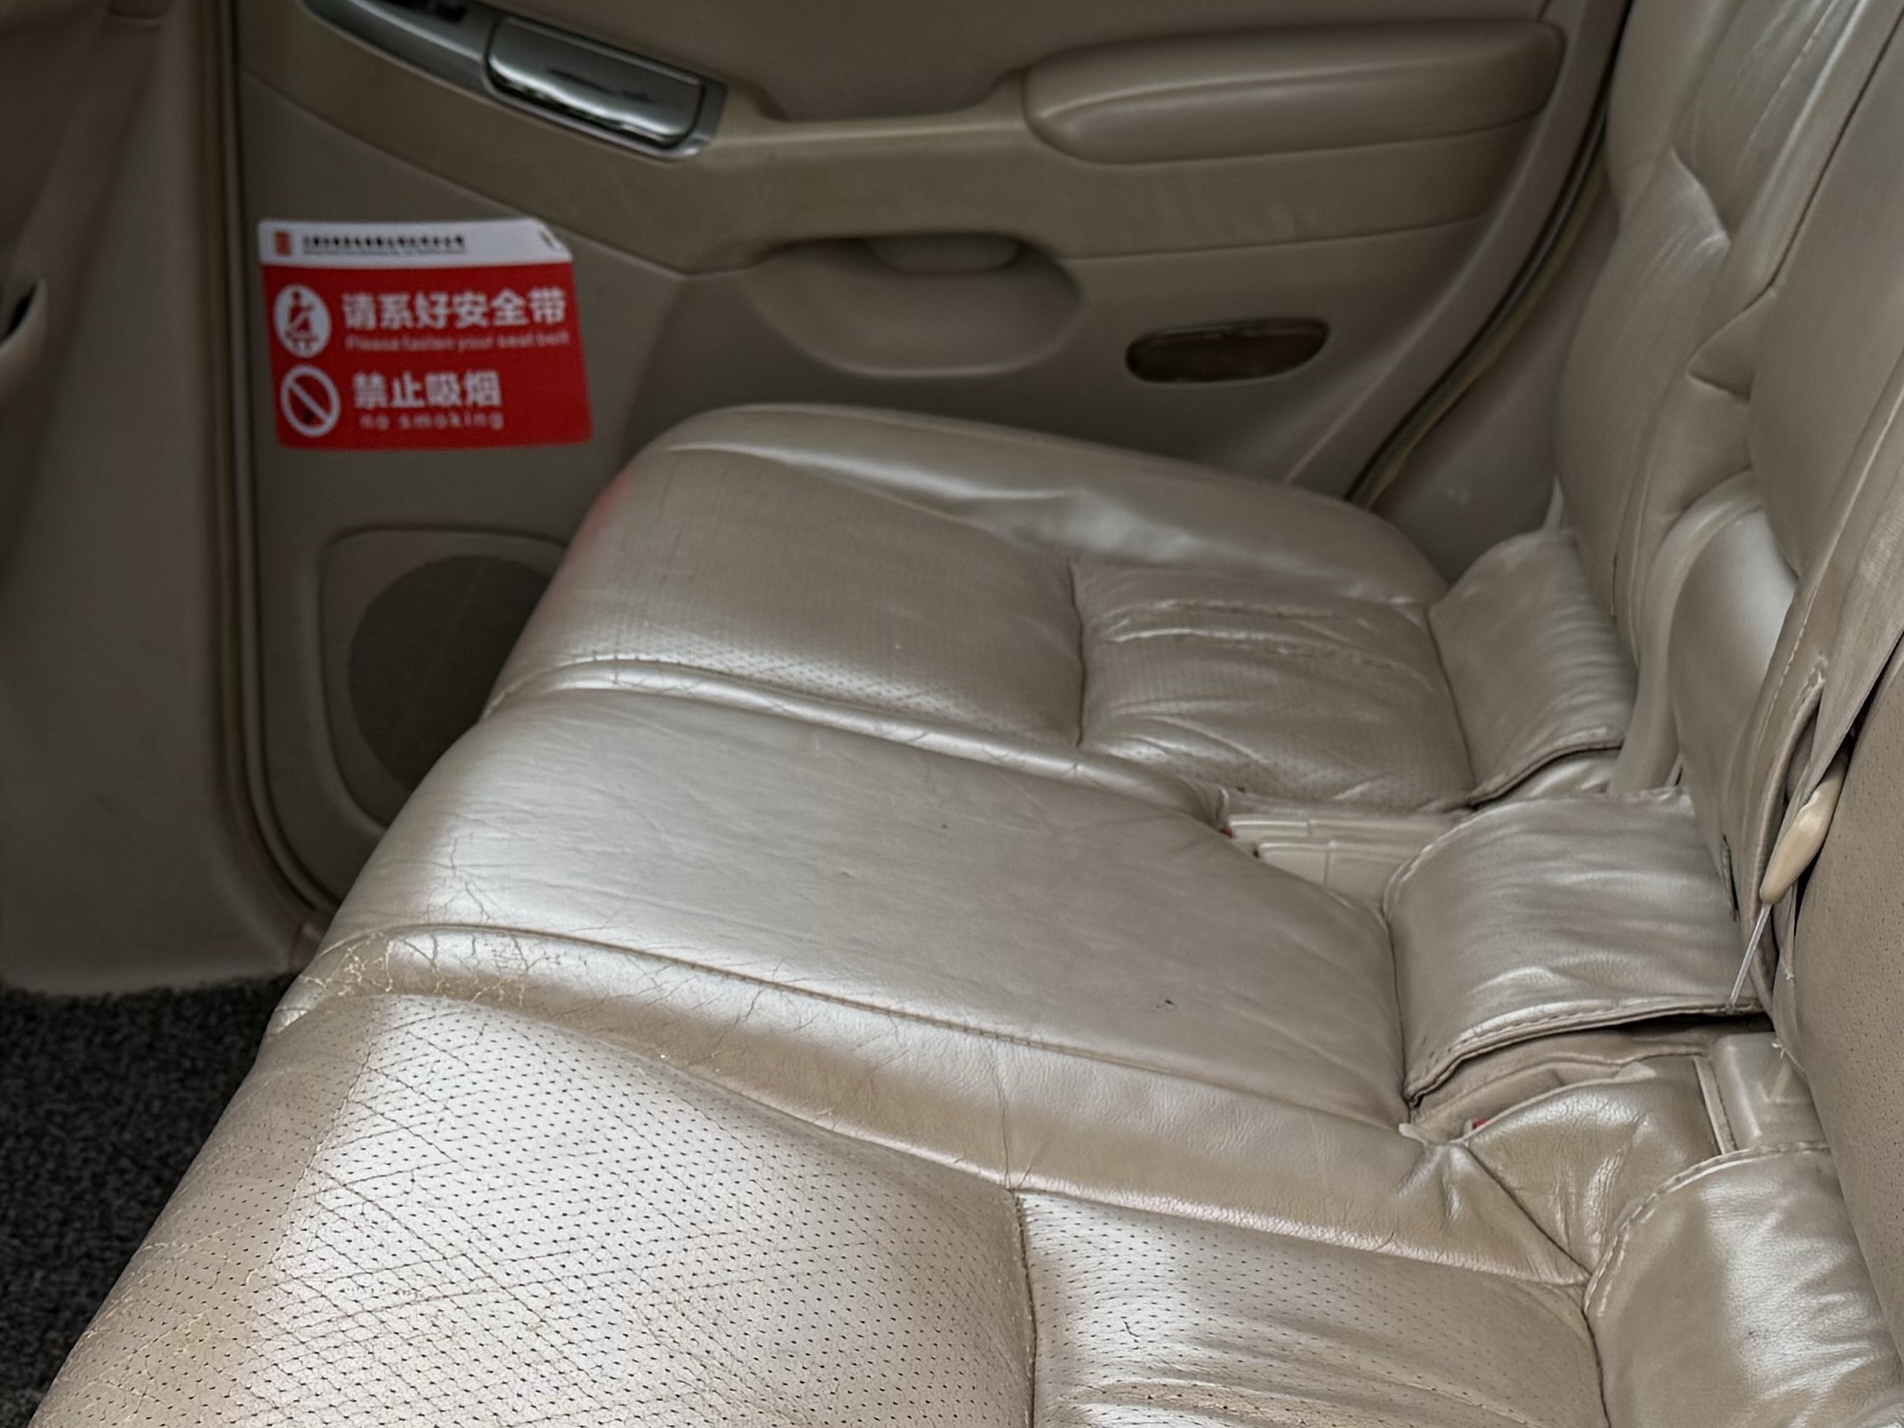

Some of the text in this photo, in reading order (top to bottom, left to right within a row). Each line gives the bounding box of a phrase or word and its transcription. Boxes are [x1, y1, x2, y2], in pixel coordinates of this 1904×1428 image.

[341, 286, 567, 331] 请系好安全带
[352, 369, 502, 410] 禁止吸烟
[359, 412, 505, 431] no smoking
